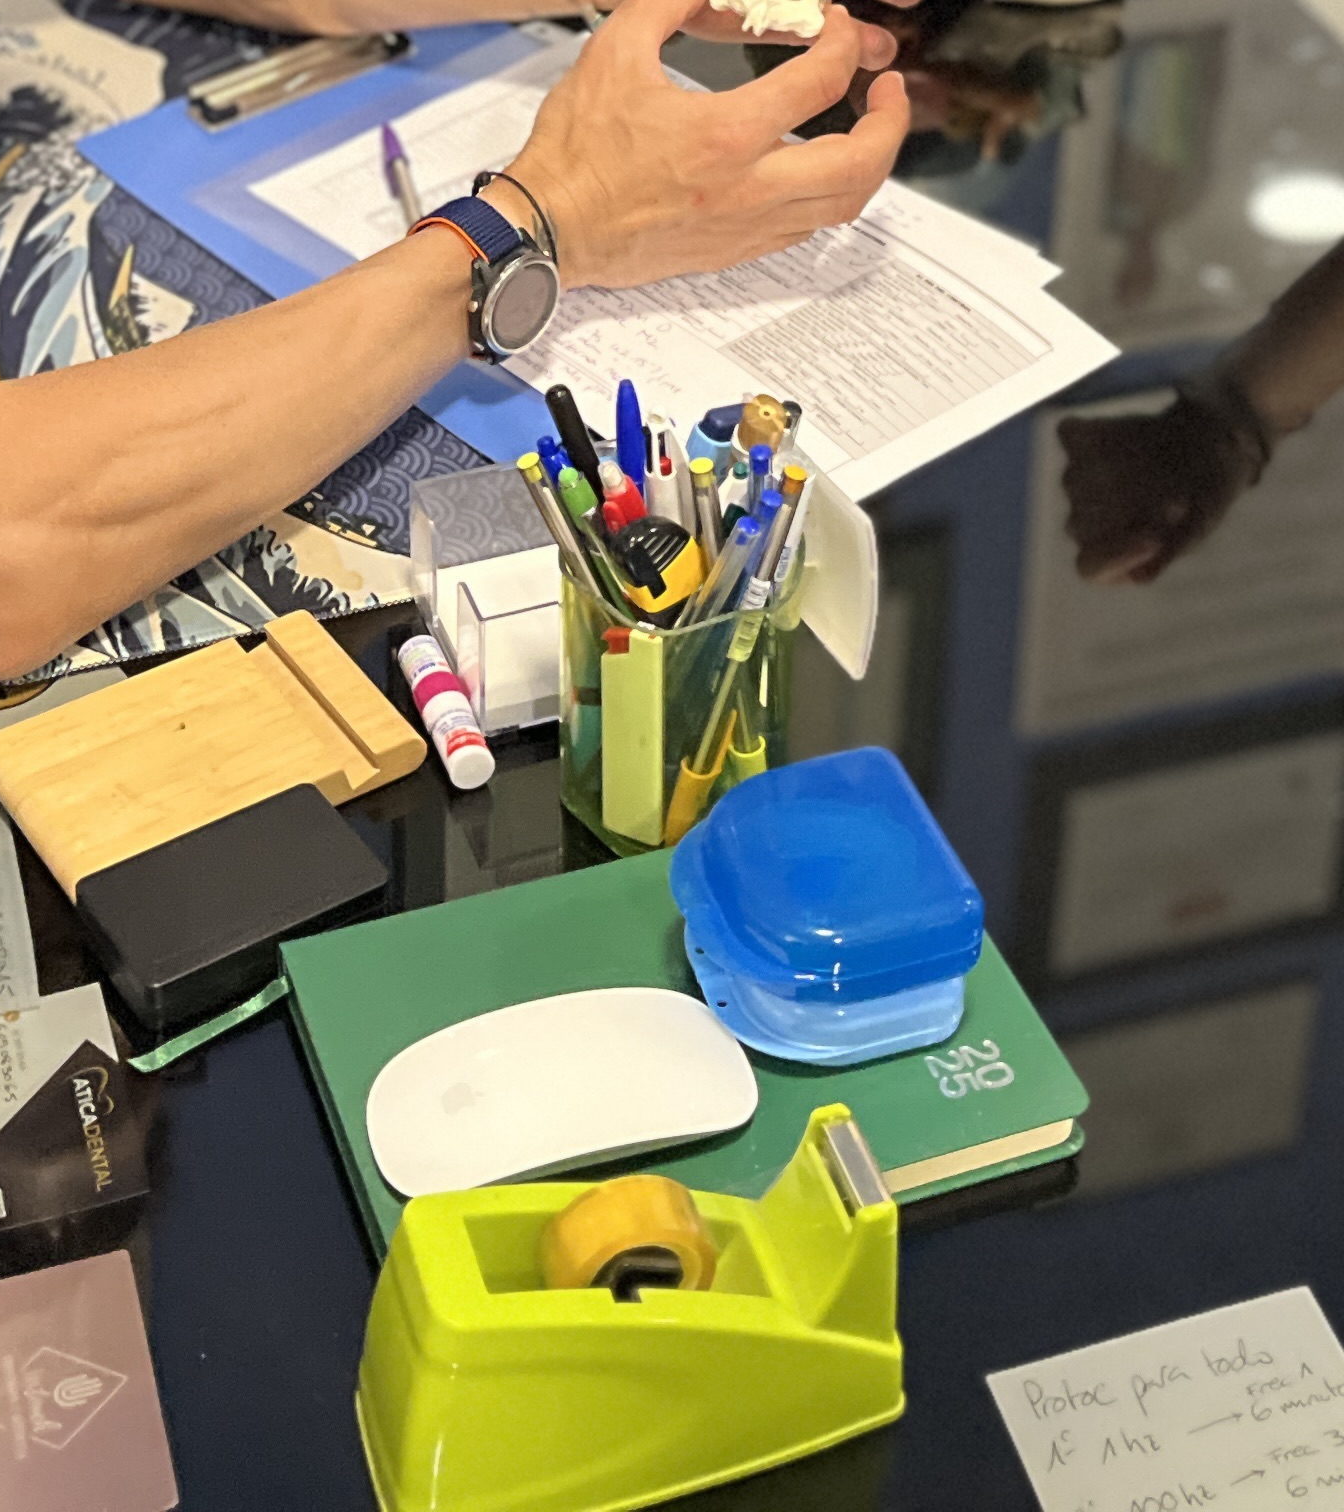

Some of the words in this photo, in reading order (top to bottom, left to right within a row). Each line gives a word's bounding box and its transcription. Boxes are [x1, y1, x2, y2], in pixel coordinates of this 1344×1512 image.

[924, 1049, 981, 1099] 25
[958, 1038, 1015, 1089] 20
[72, 1077, 114, 1193] ATICADENTAL
